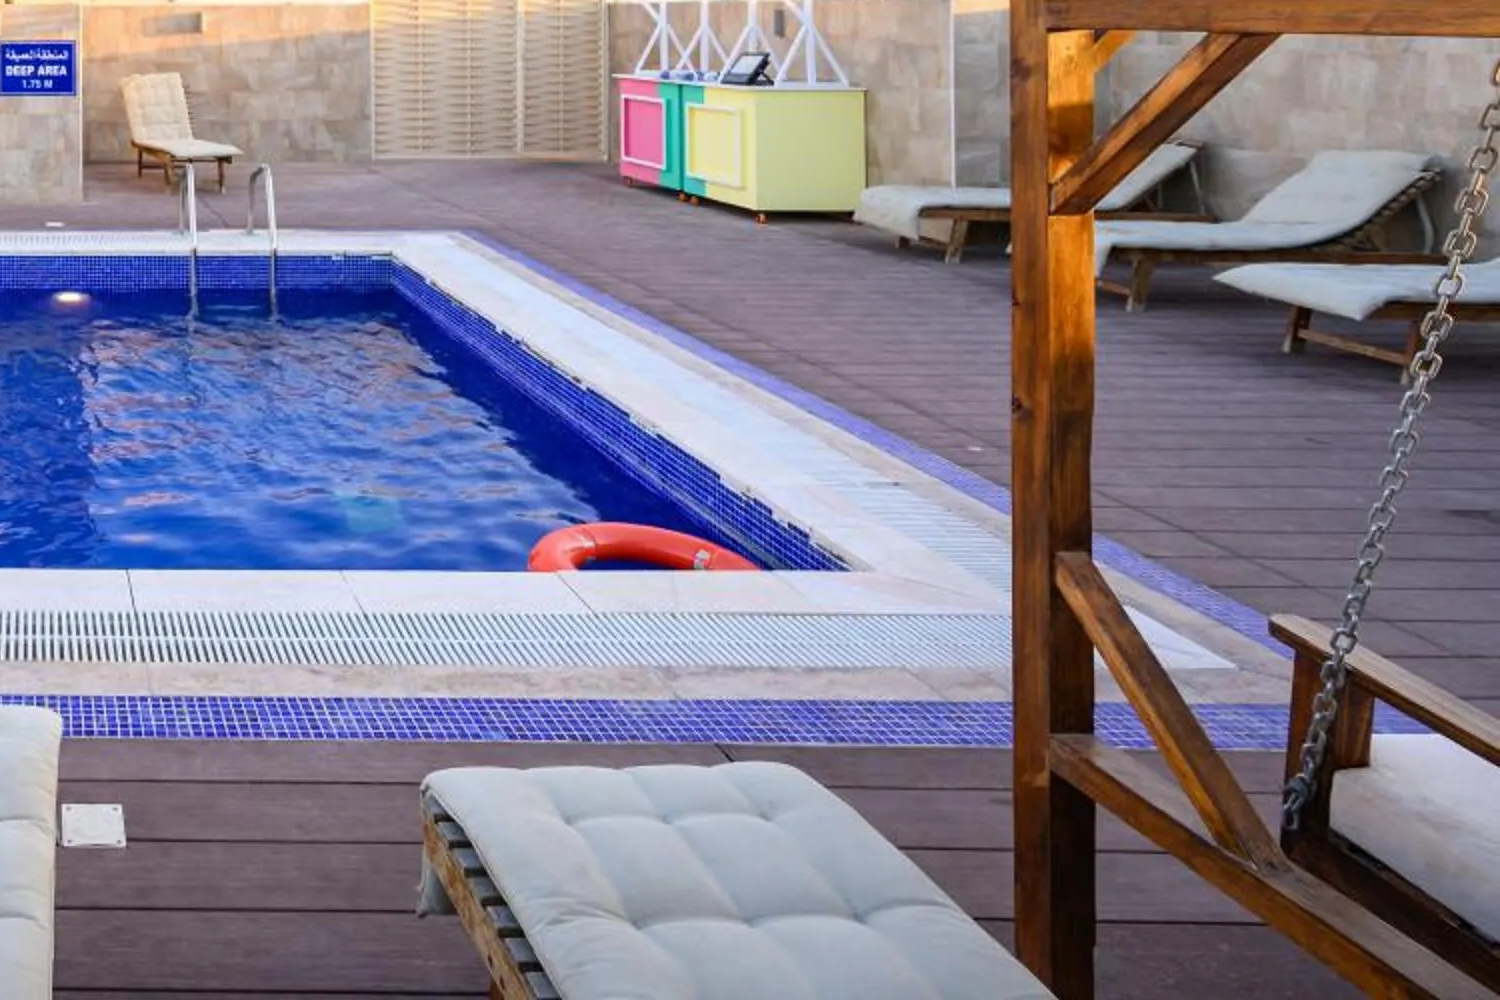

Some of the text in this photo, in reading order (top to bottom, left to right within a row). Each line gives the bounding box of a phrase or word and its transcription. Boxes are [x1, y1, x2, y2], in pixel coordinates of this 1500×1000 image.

[5, 65, 68, 77] DEEP AREA
[43, 79, 53, 89] M
